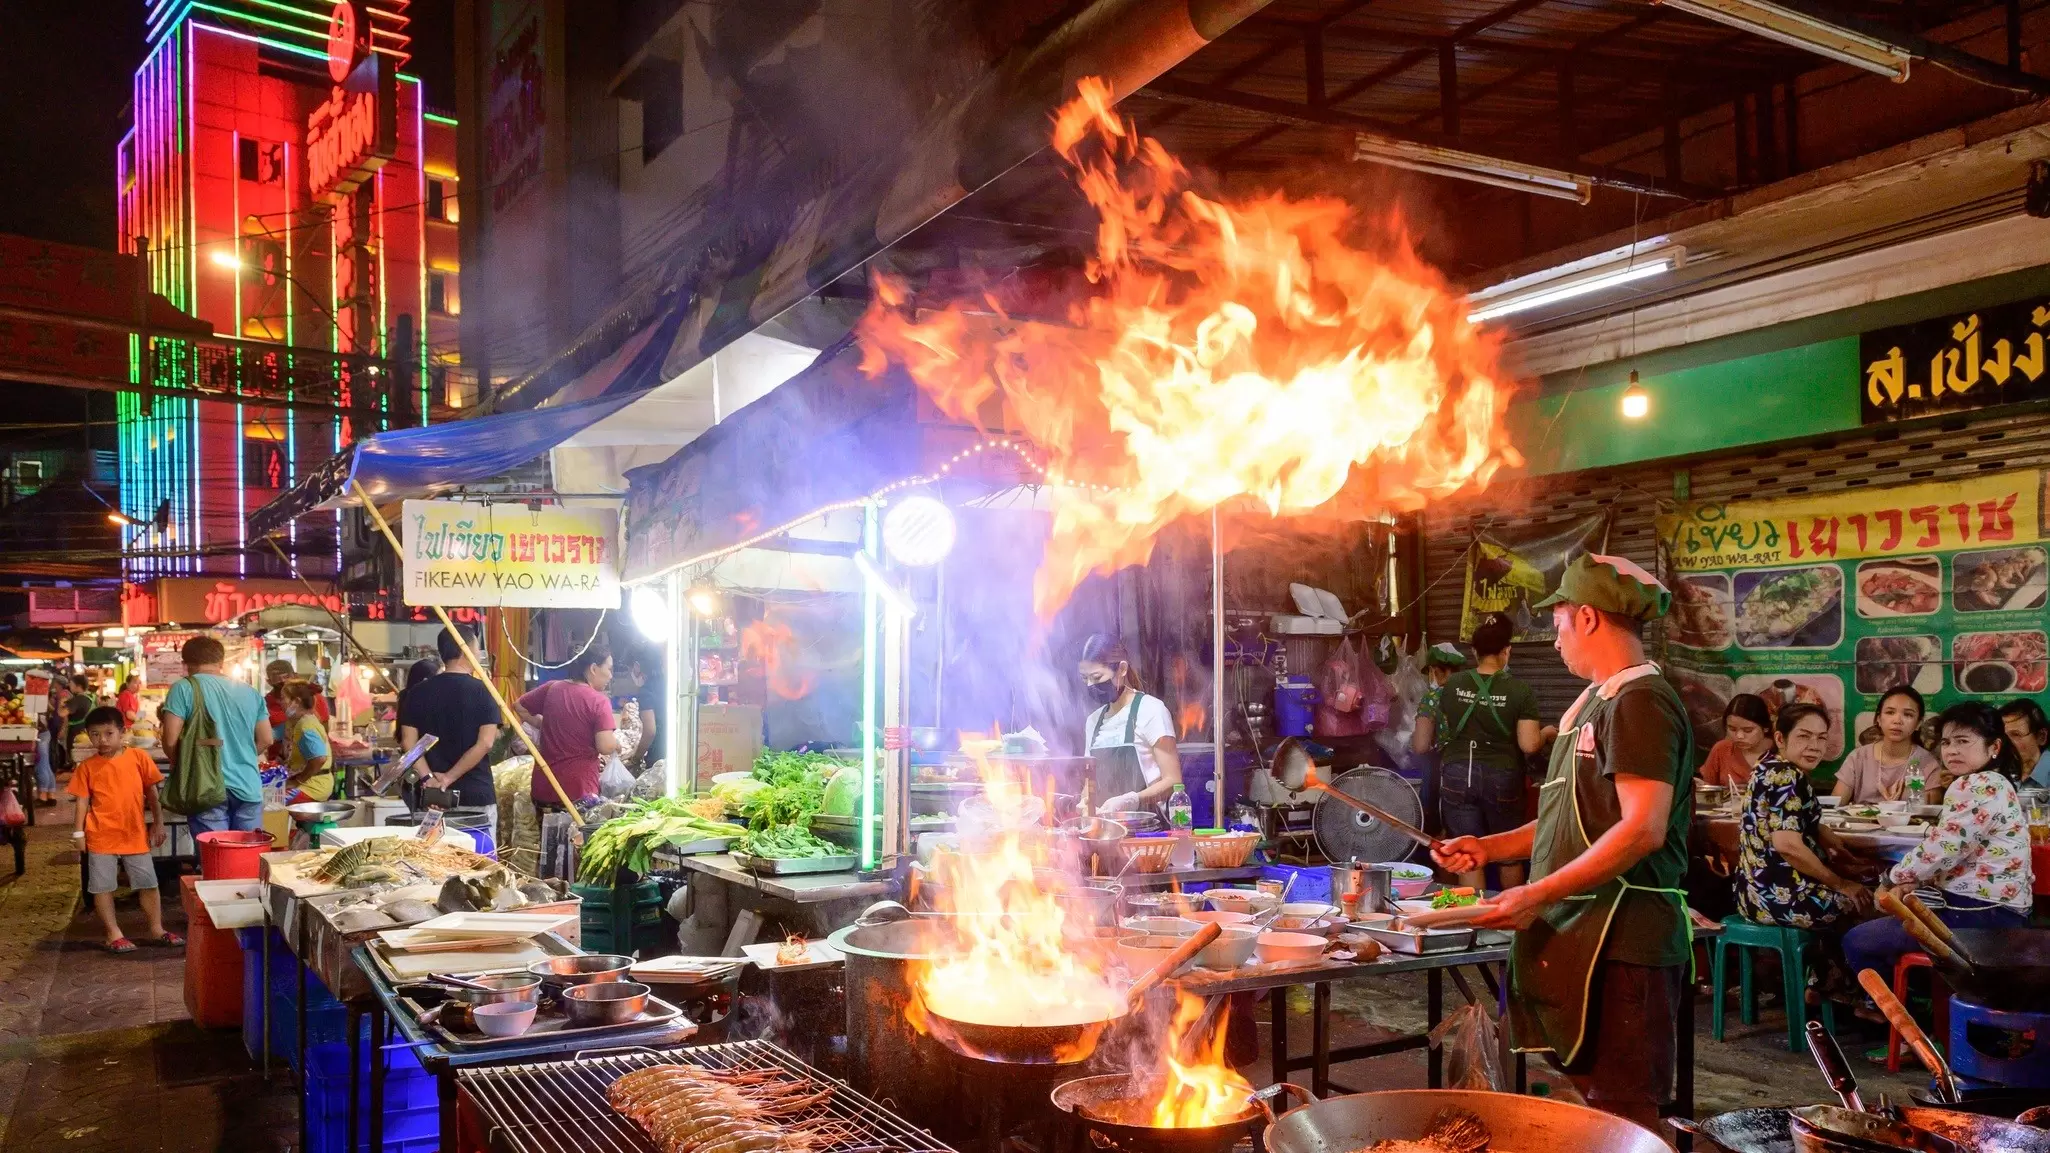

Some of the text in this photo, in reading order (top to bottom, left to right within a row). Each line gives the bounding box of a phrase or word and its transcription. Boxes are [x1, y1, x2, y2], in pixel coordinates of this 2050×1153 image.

[1787, 492, 2019, 558] เยาวราช
[1701, 555, 1724, 569] YAO
[1726, 550, 1782, 565] WA-RAT
[414, 571, 601, 592] FIKEAW YAO WA-RA
